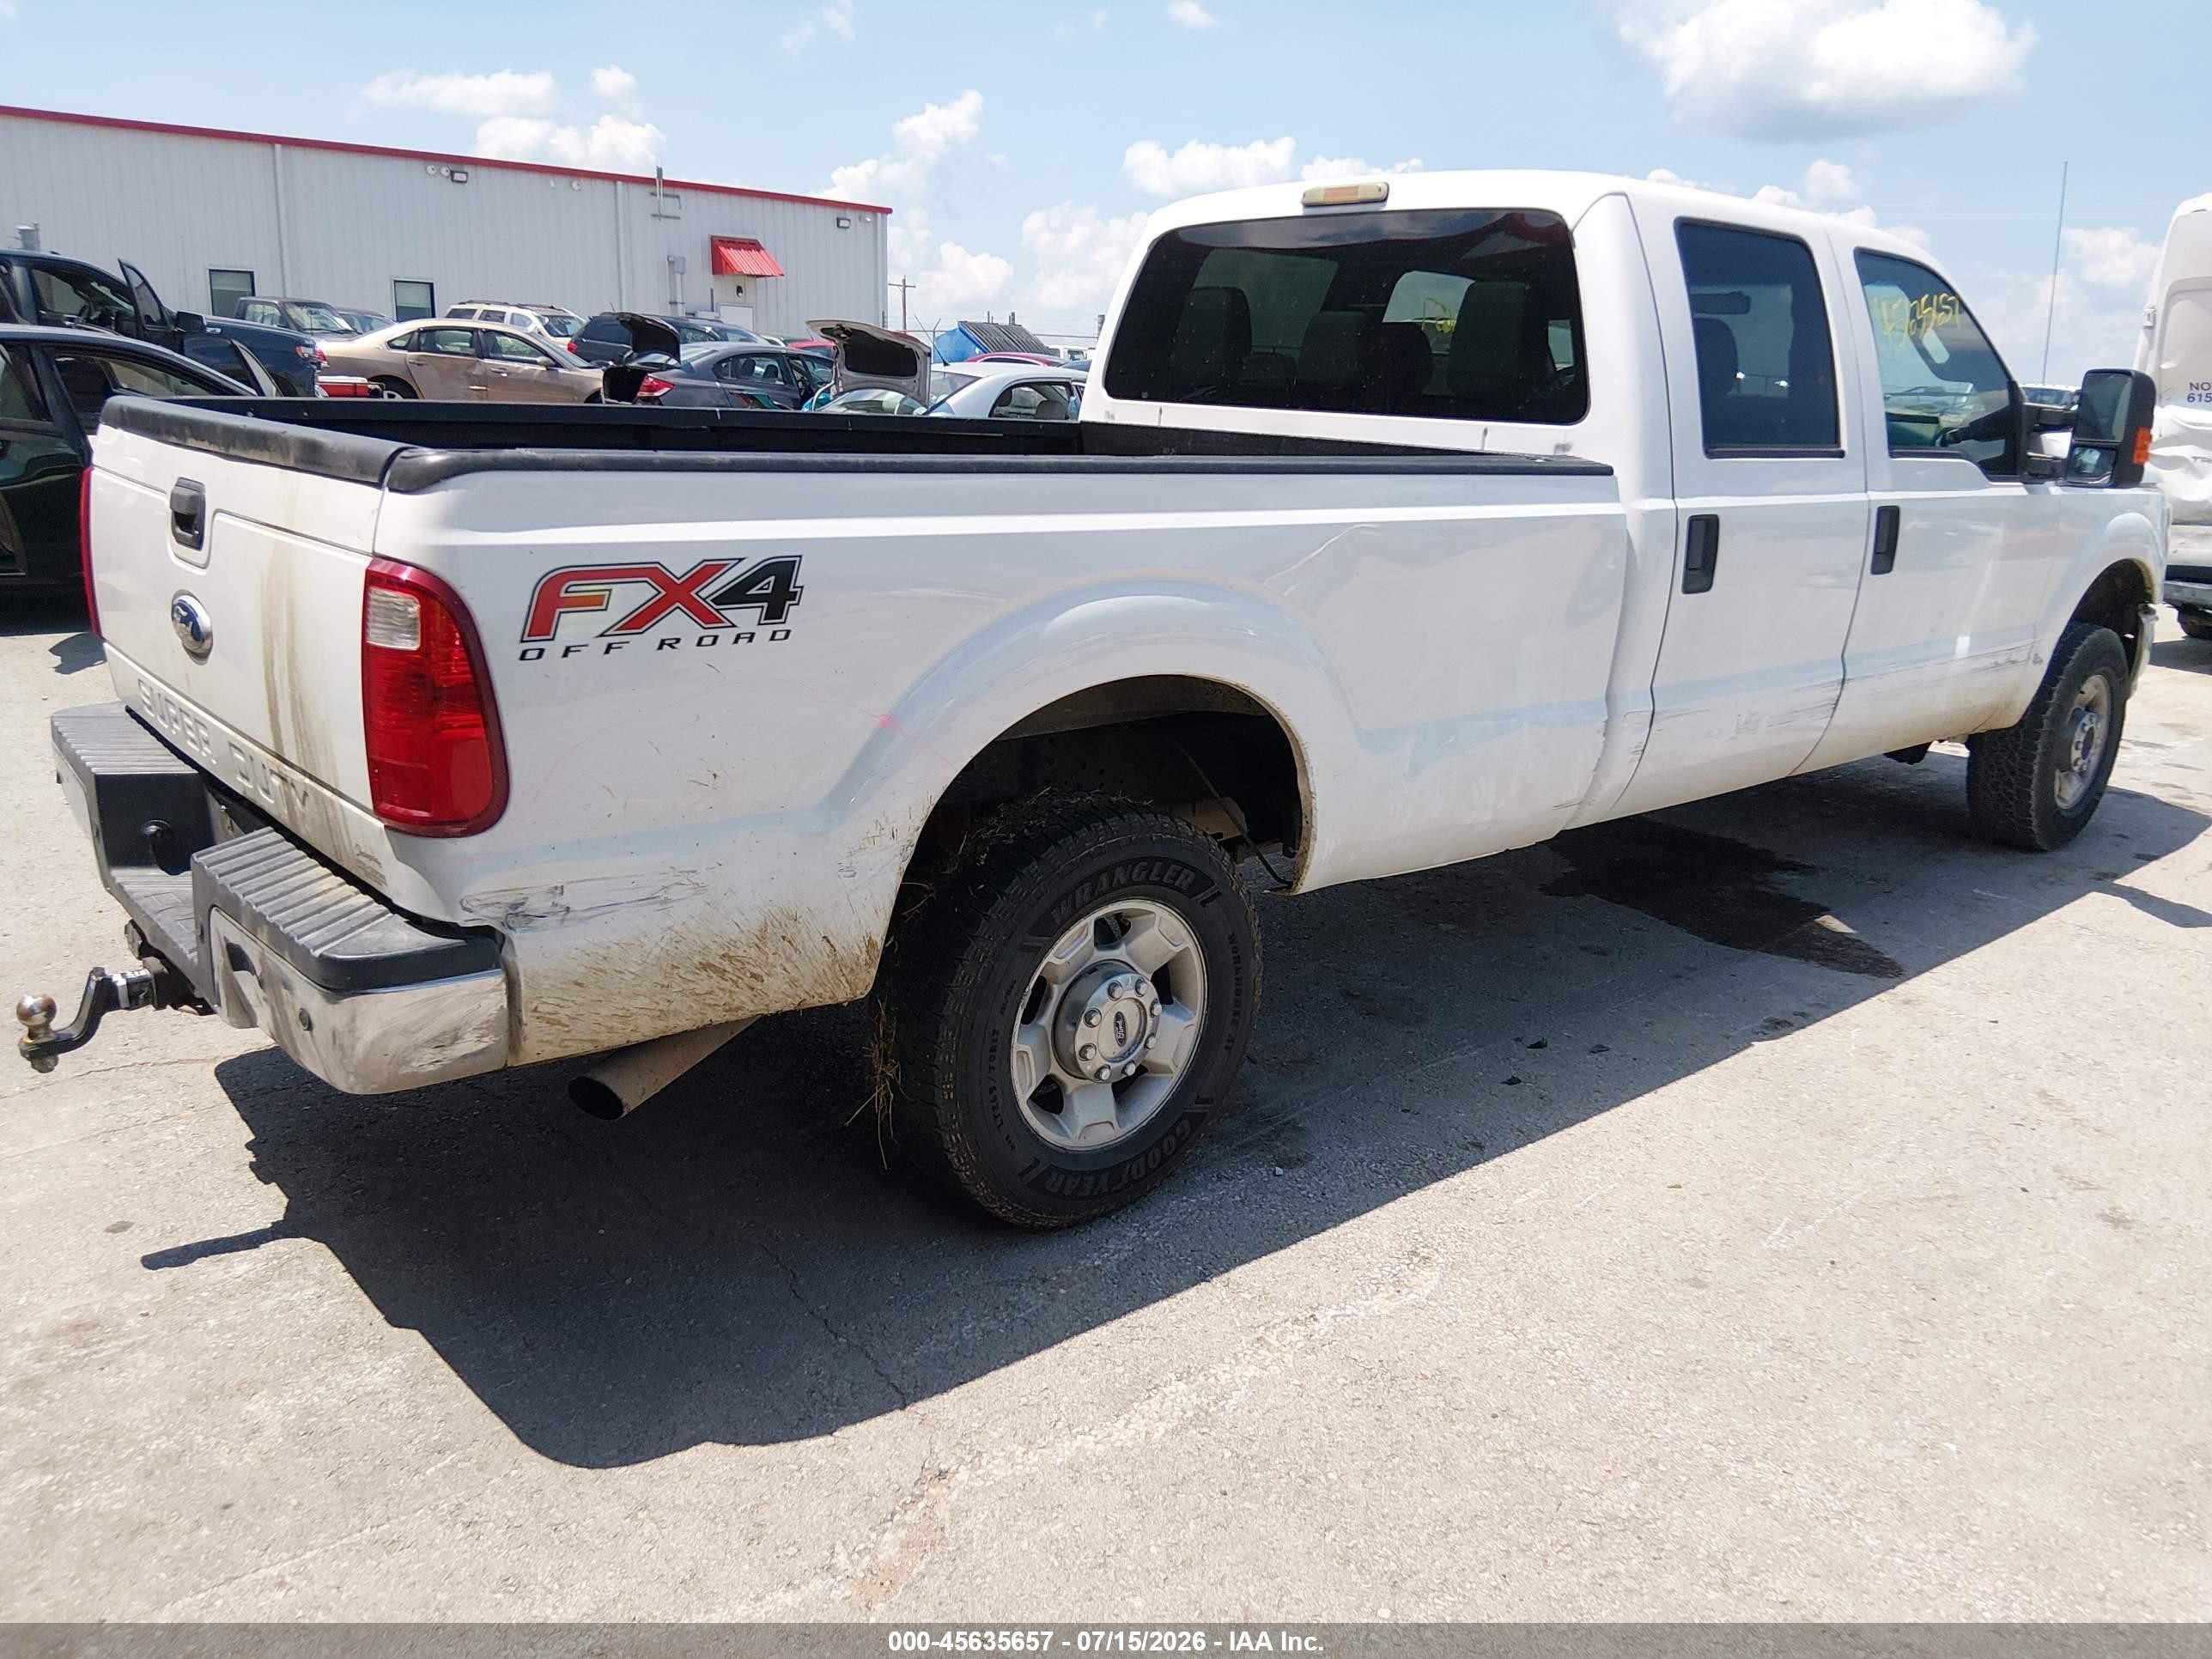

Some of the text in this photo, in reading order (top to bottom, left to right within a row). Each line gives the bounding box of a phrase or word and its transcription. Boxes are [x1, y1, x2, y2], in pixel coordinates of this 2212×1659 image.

[519, 555, 804, 644] FX4
[518, 629, 793, 661] OFF ROAD
[137, 678, 310, 817] SUPER DUTY
[1049, 860, 1196, 927] WRANGLER
[1044, 1119, 1192, 1195] GOODYEAR
